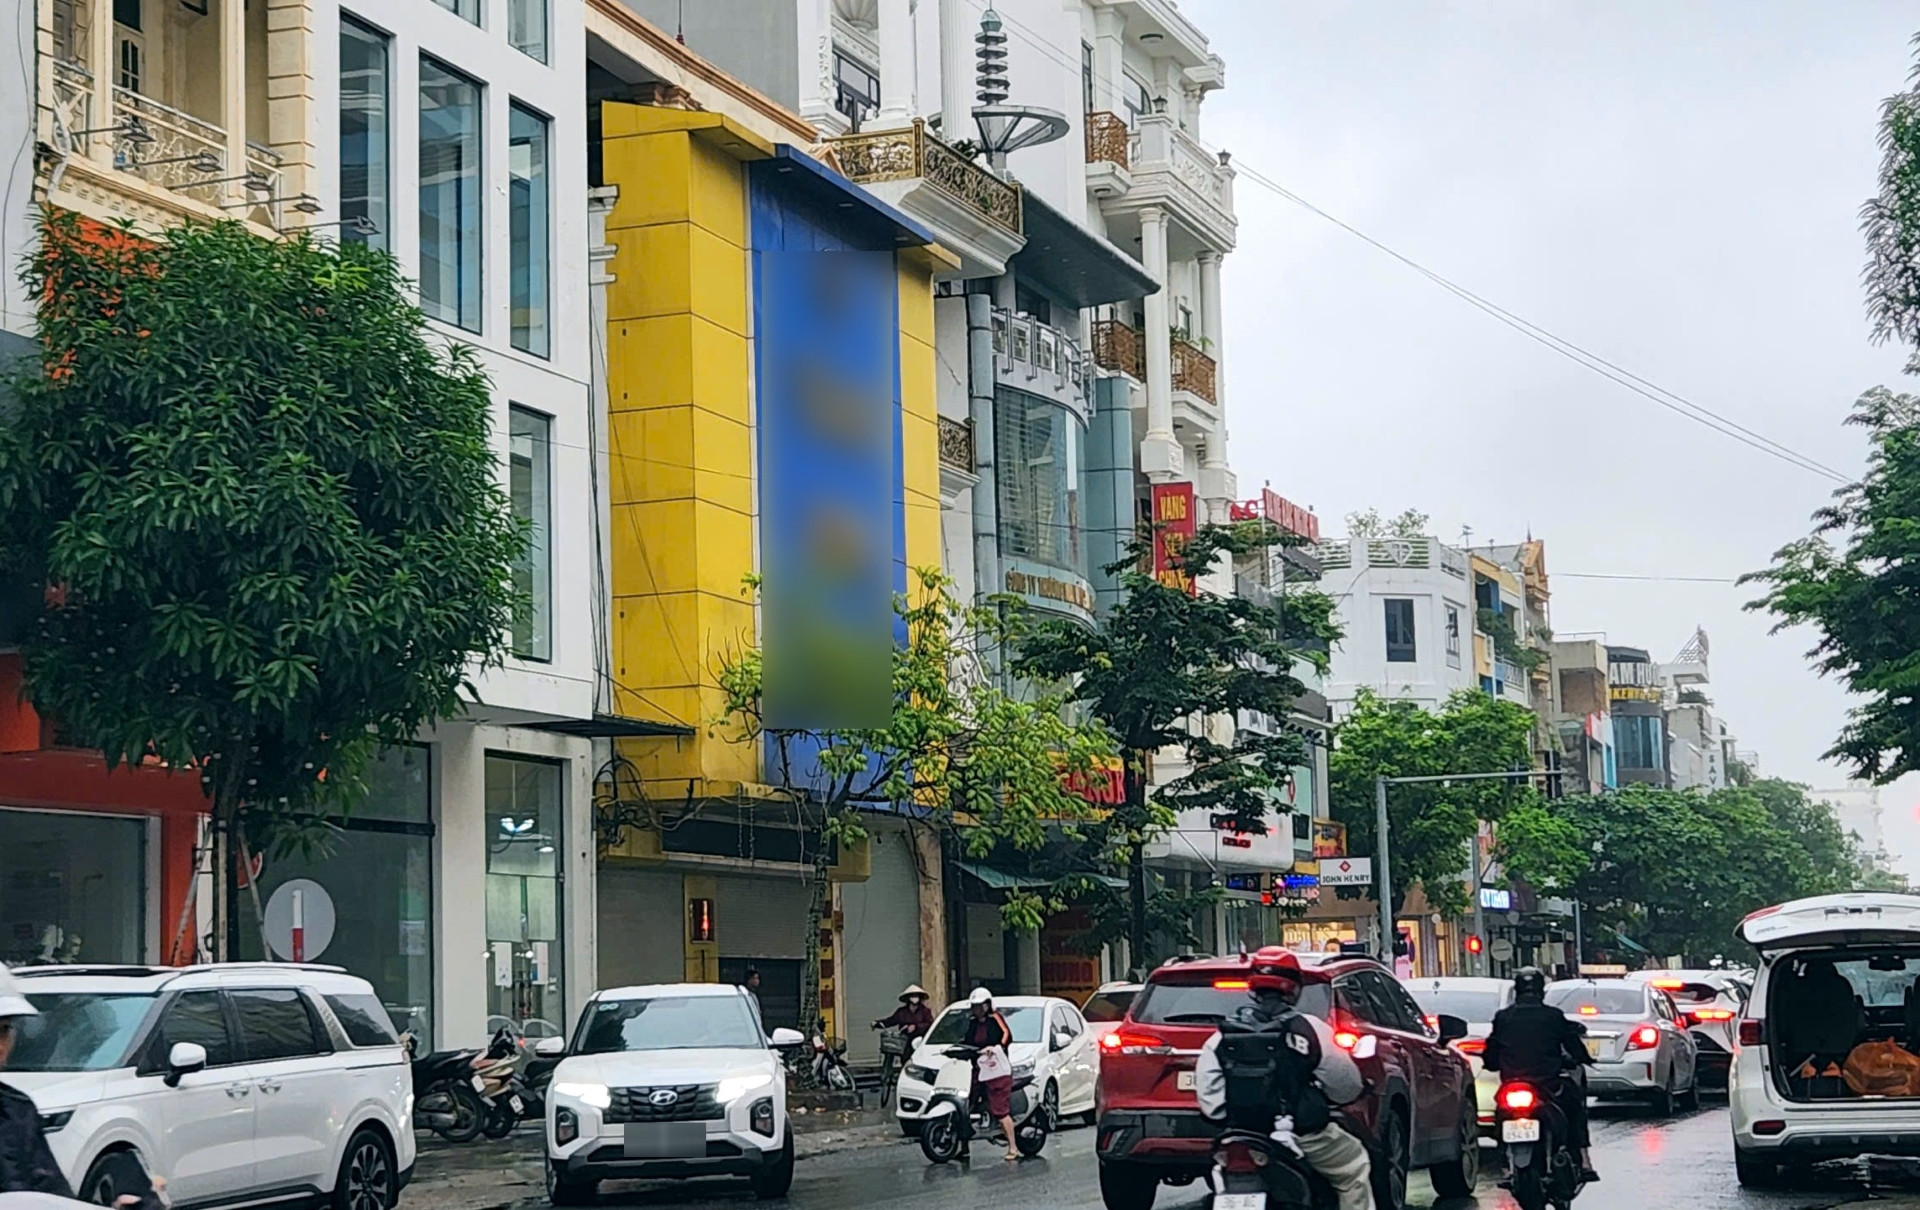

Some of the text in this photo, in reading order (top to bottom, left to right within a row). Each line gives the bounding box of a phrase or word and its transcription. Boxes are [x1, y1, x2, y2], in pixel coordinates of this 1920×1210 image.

[1160, 491, 1186, 520] VÀNG
[1709, 754, 1717, 788] SAV
[1323, 875, 1341, 883] JOHN
[1344, 874, 1369, 882] HENRY
